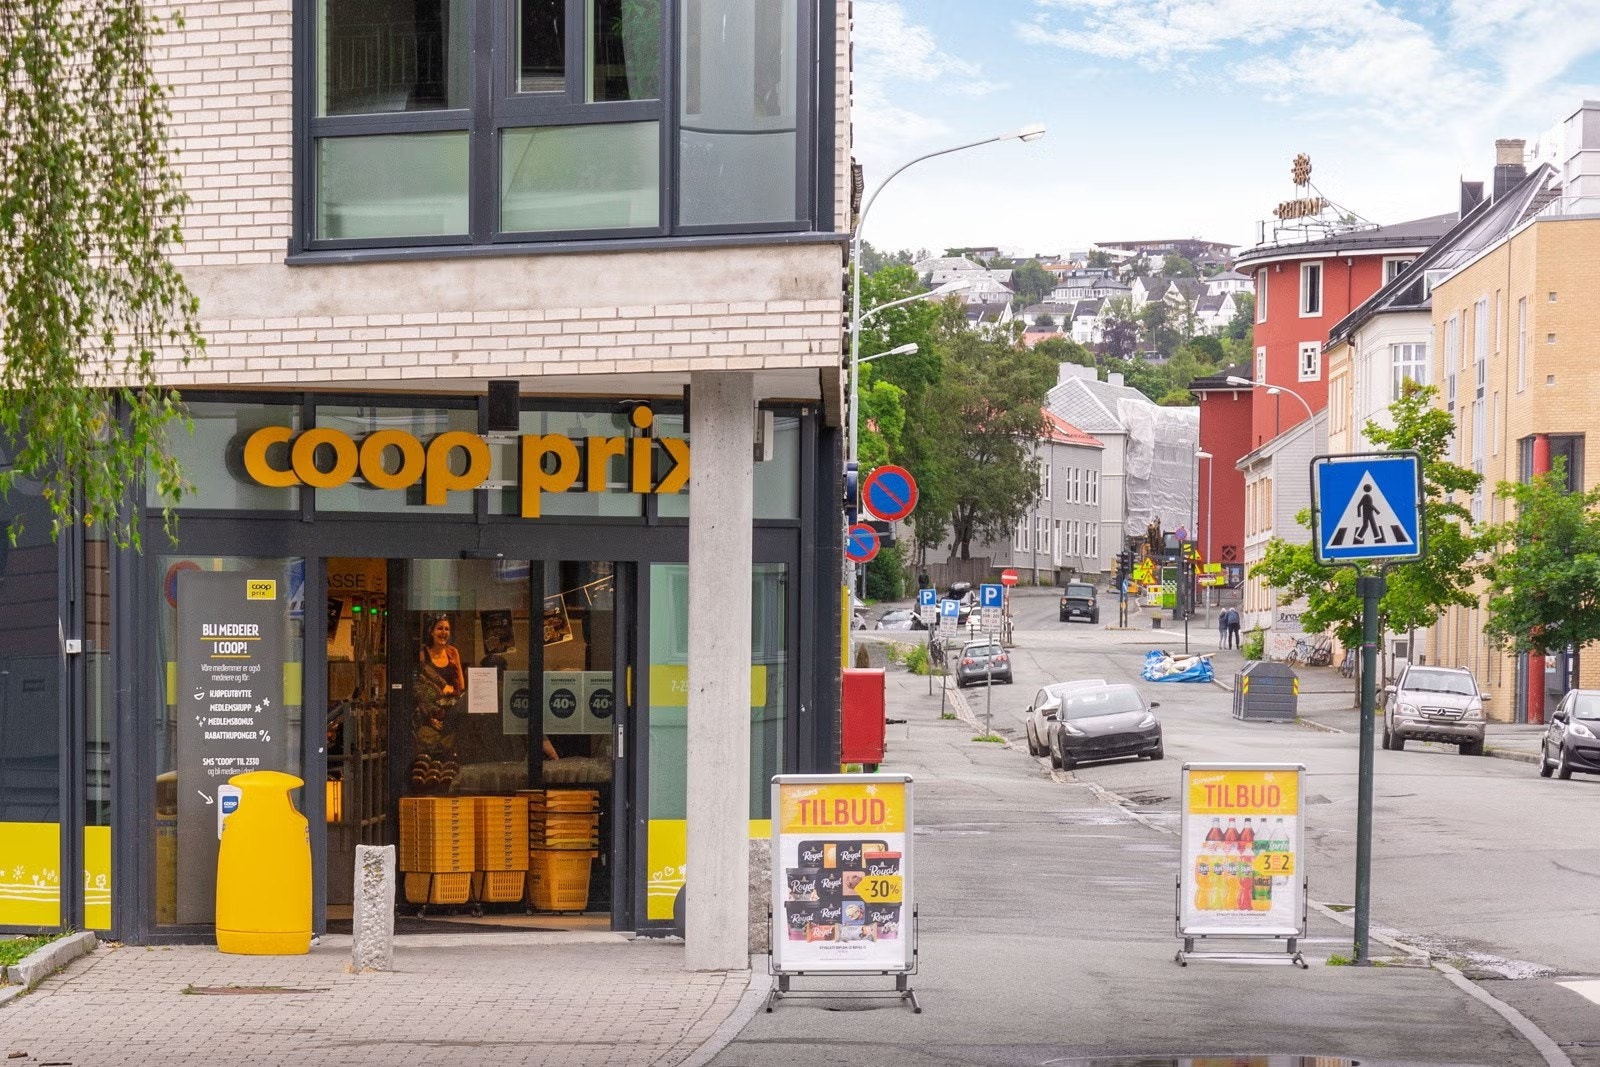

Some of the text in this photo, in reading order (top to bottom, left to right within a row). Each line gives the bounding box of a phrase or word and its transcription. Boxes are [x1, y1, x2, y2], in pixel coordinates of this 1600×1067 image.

[243, 405, 691, 518] coop prix
[251, 583, 272, 591] coop
[923, 591, 933, 604] P
[985, 587, 998, 605] P
[945, 602, 956, 615] P
[202, 623, 259, 636] BLI MEDEIER
[214, 642, 248, 654] I COOP!
[210, 690, 252, 698] KJØPEUTBYTTE
[210, 704, 252, 712] MEDLEMSKUPP
[208, 718, 254, 726] MEDLEMSBONUS
[202, 758, 214, 766] SMS
[237, 758, 245, 766] TIL
[246, 758, 260, 766] 2330
[1204, 784, 1281, 808] TILBUD
[798, 798, 886, 826] TILBUD
[802, 850, 824, 862] Royal
[840, 850, 861, 862] Royal
[1264, 854, 1271, 870] 3
[1282, 854, 1290, 870] 2
[869, 864, 894, 876] Royal
[790, 880, 816, 894] Royal
[821, 877, 842, 889] Royal
[865, 880, 899, 898] -30%
[791, 912, 814, 925] Royal
[820, 907, 841, 919] Royal
[871, 911, 894, 924] Royal
[812, 926, 832, 937] Royal
